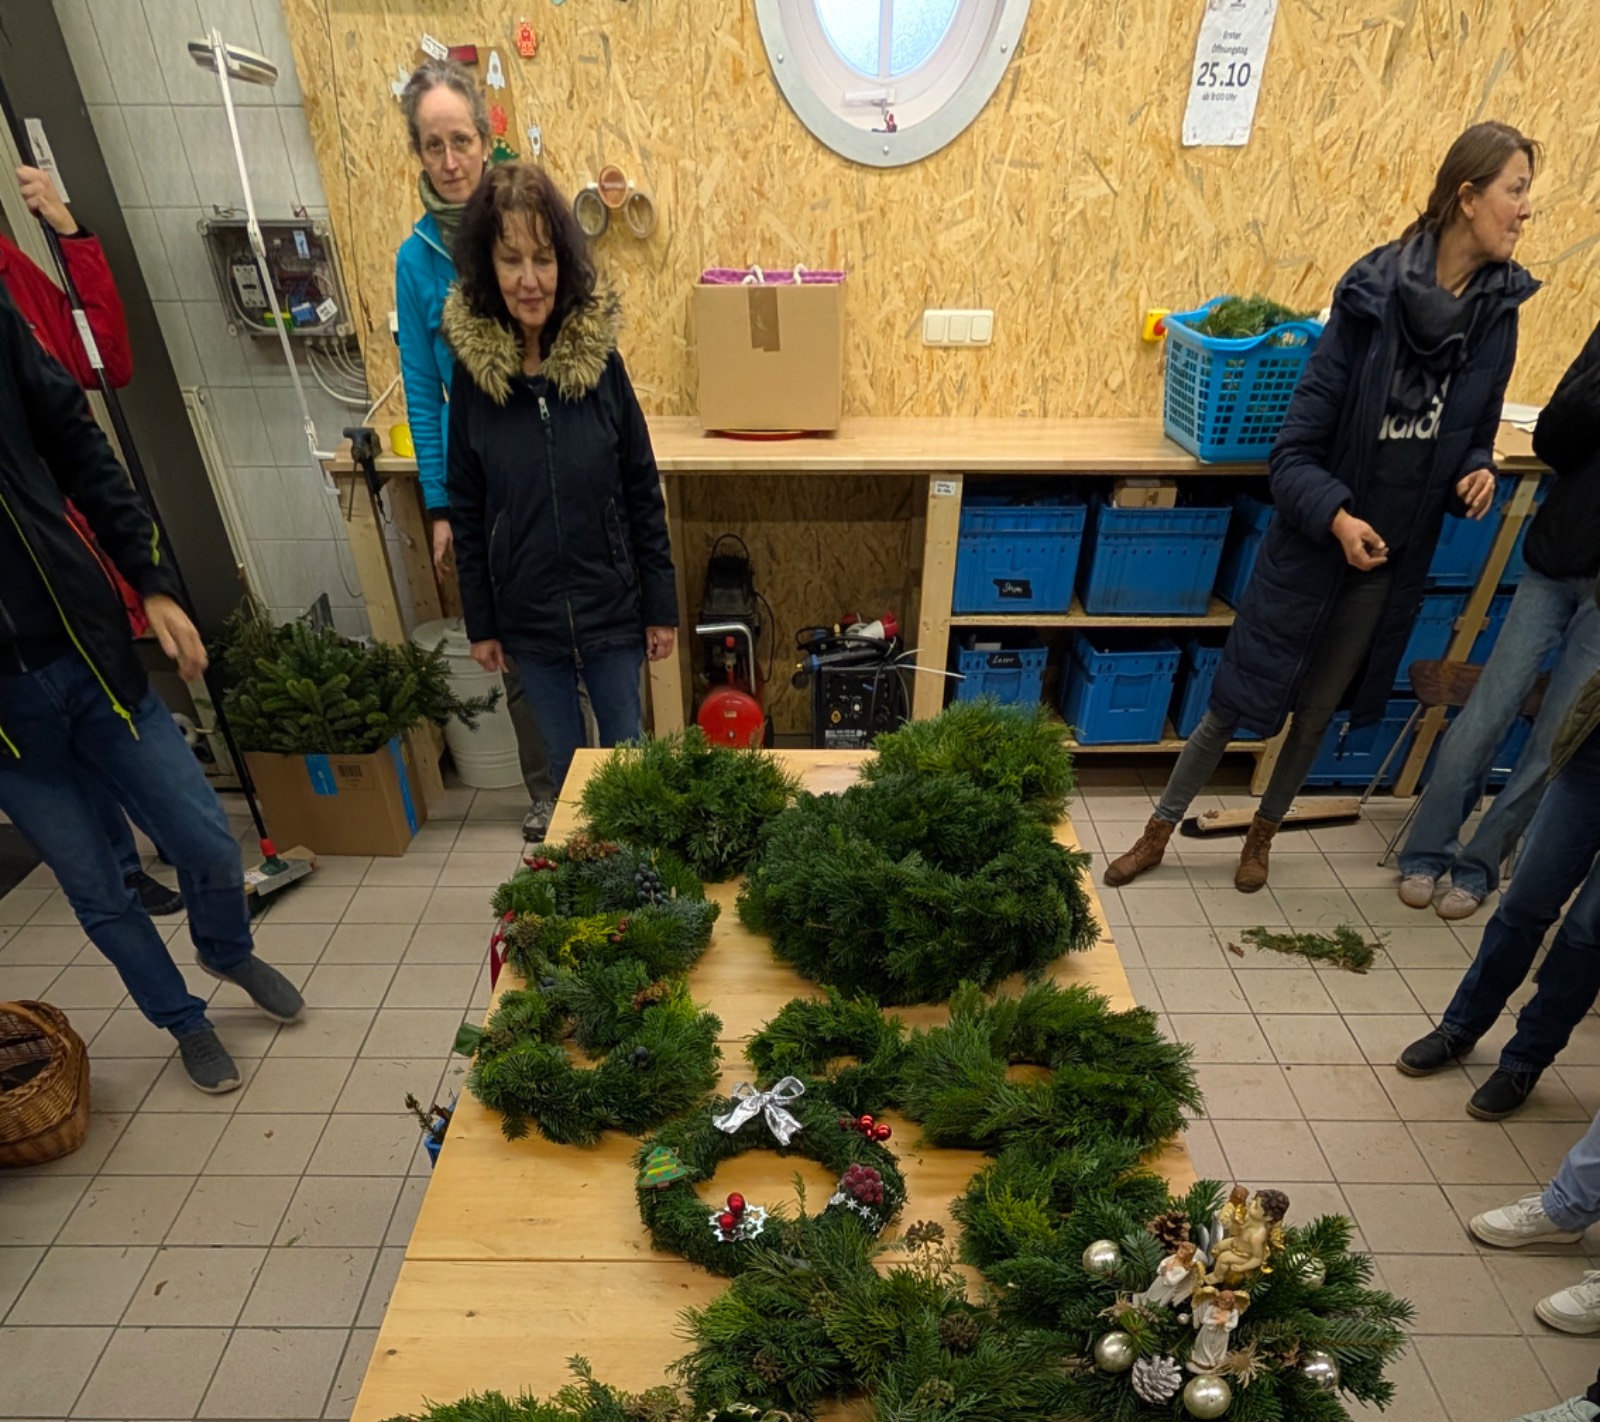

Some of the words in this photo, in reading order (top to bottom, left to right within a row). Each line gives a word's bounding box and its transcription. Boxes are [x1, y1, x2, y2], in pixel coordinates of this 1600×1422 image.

[1223, 31, 1242, 40] Erster
[1211, 43, 1249, 56] Öffnungstag
[1197, 61, 1251, 88] 25.10
[1202, 92, 1210, 101] ab
[1225, 92, 1238, 101] Uhr
